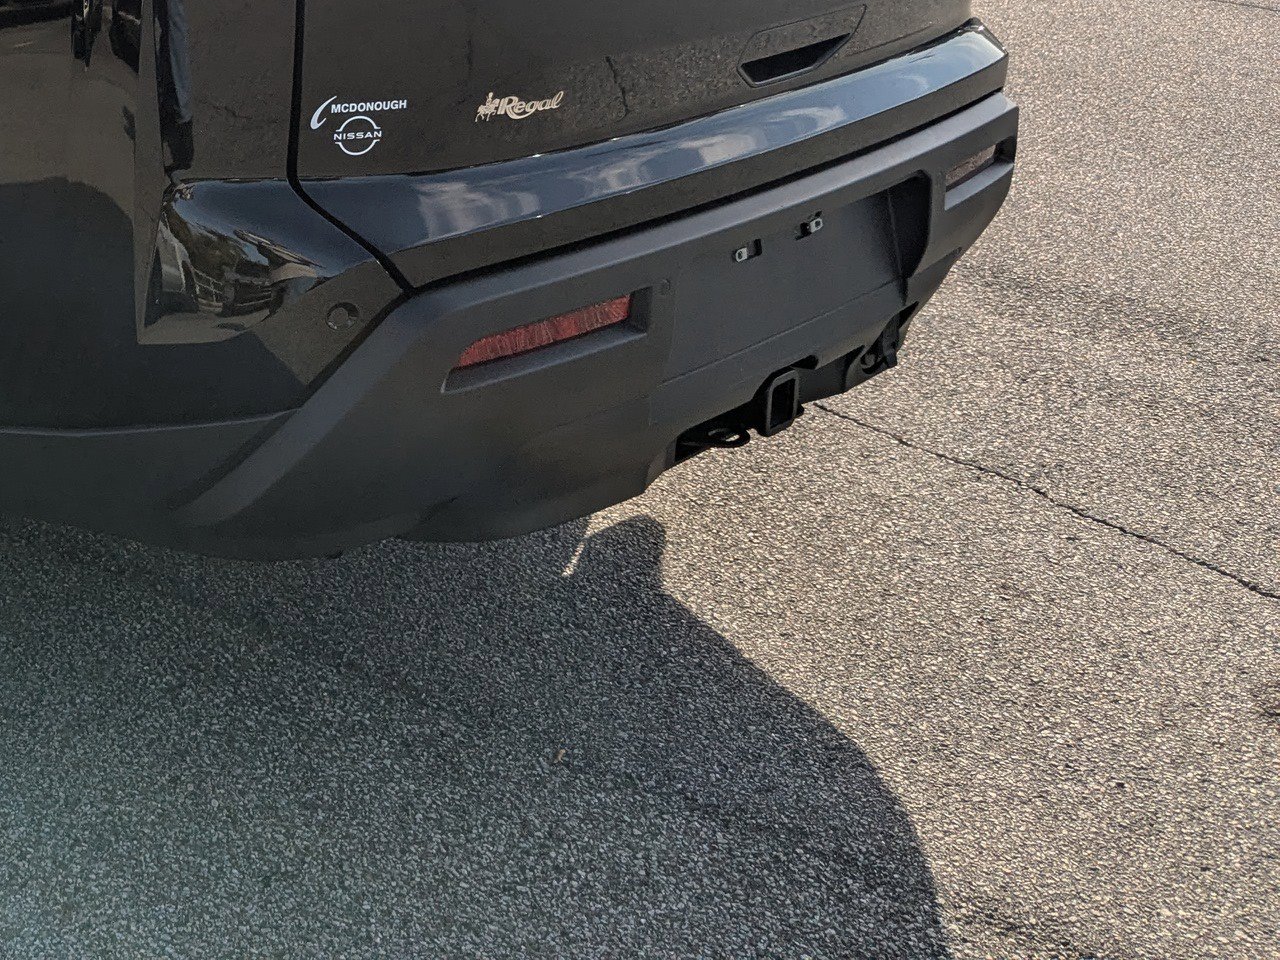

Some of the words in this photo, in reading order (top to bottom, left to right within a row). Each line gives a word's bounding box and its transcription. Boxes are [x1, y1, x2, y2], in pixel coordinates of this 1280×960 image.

[331, 99, 407, 113] MCDONOUGH
[497, 91, 564, 119] Regal
[333, 130, 382, 141] NISSAN
